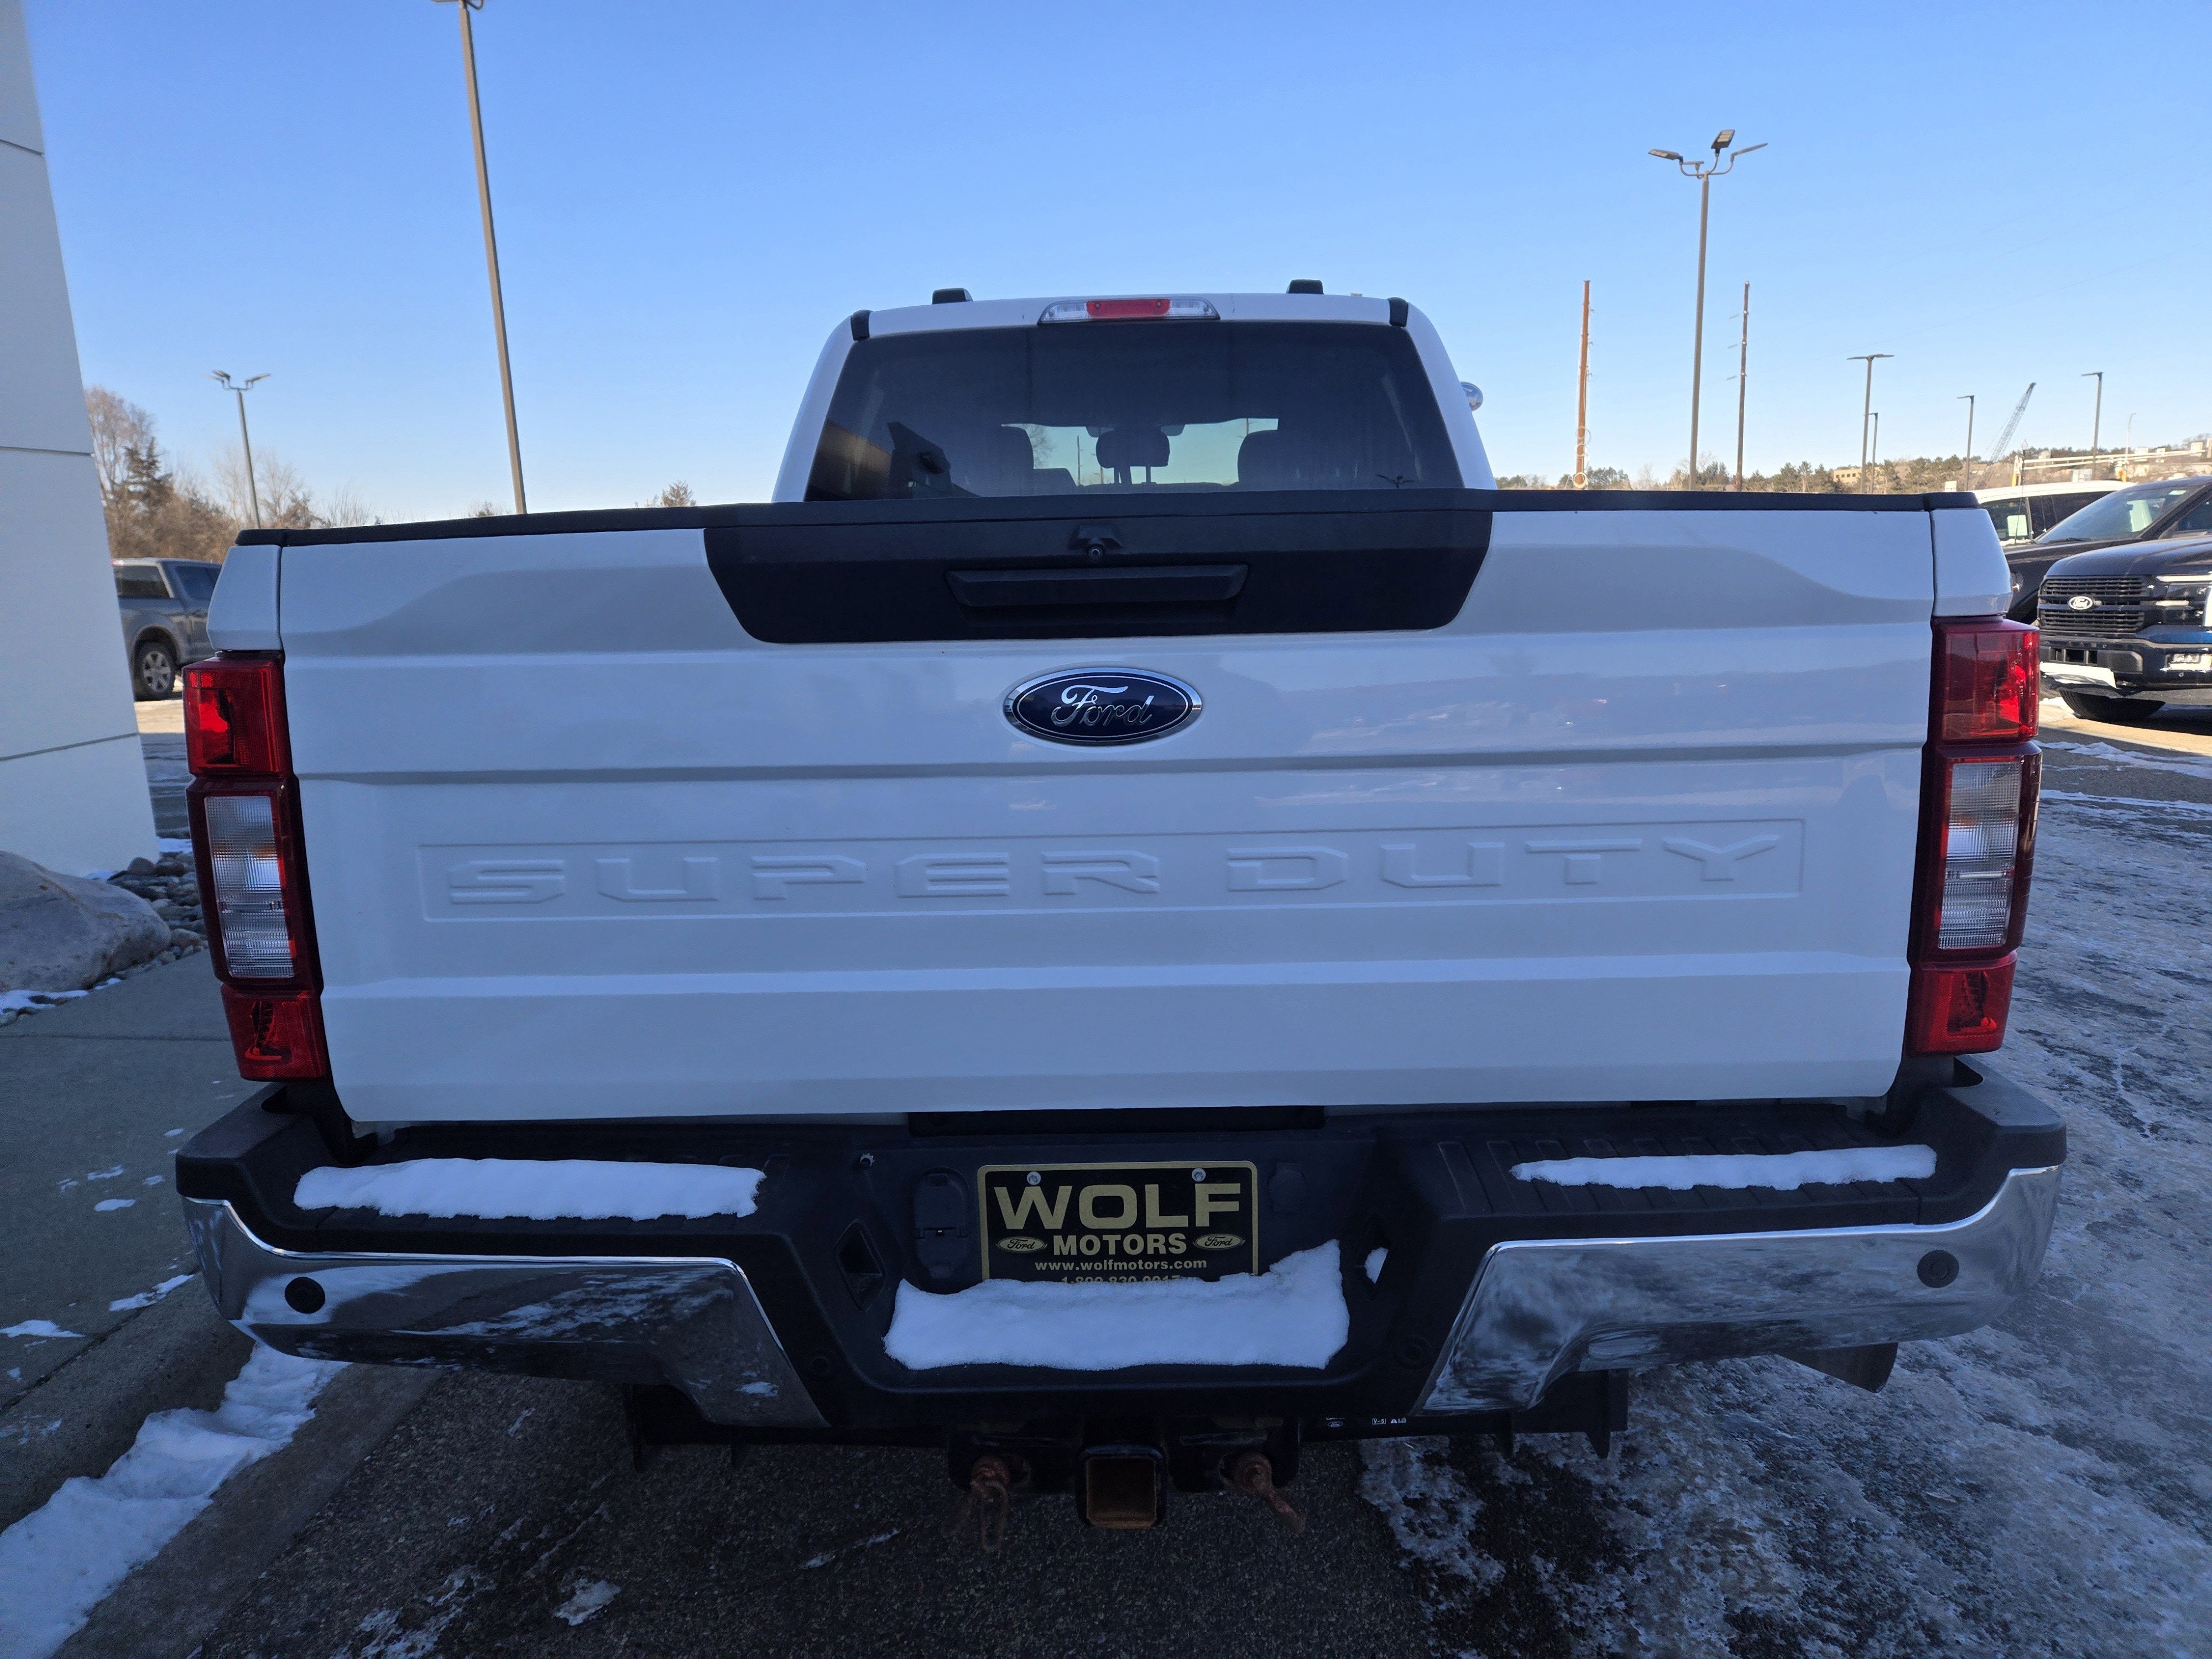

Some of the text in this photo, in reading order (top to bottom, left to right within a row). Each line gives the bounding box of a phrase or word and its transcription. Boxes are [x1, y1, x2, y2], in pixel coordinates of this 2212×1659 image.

[1051, 685, 1155, 726] Ford
[449, 834, 1779, 904] SUPER DUTY
[995, 1183, 1241, 1229] WOLF
[1007, 1239, 1035, 1249] Ford
[1053, 1234, 1187, 1256] MOTORS
[1204, 1236, 1233, 1246] Ford
[1035, 1259, 1207, 1271] www.wolfmotors.com
